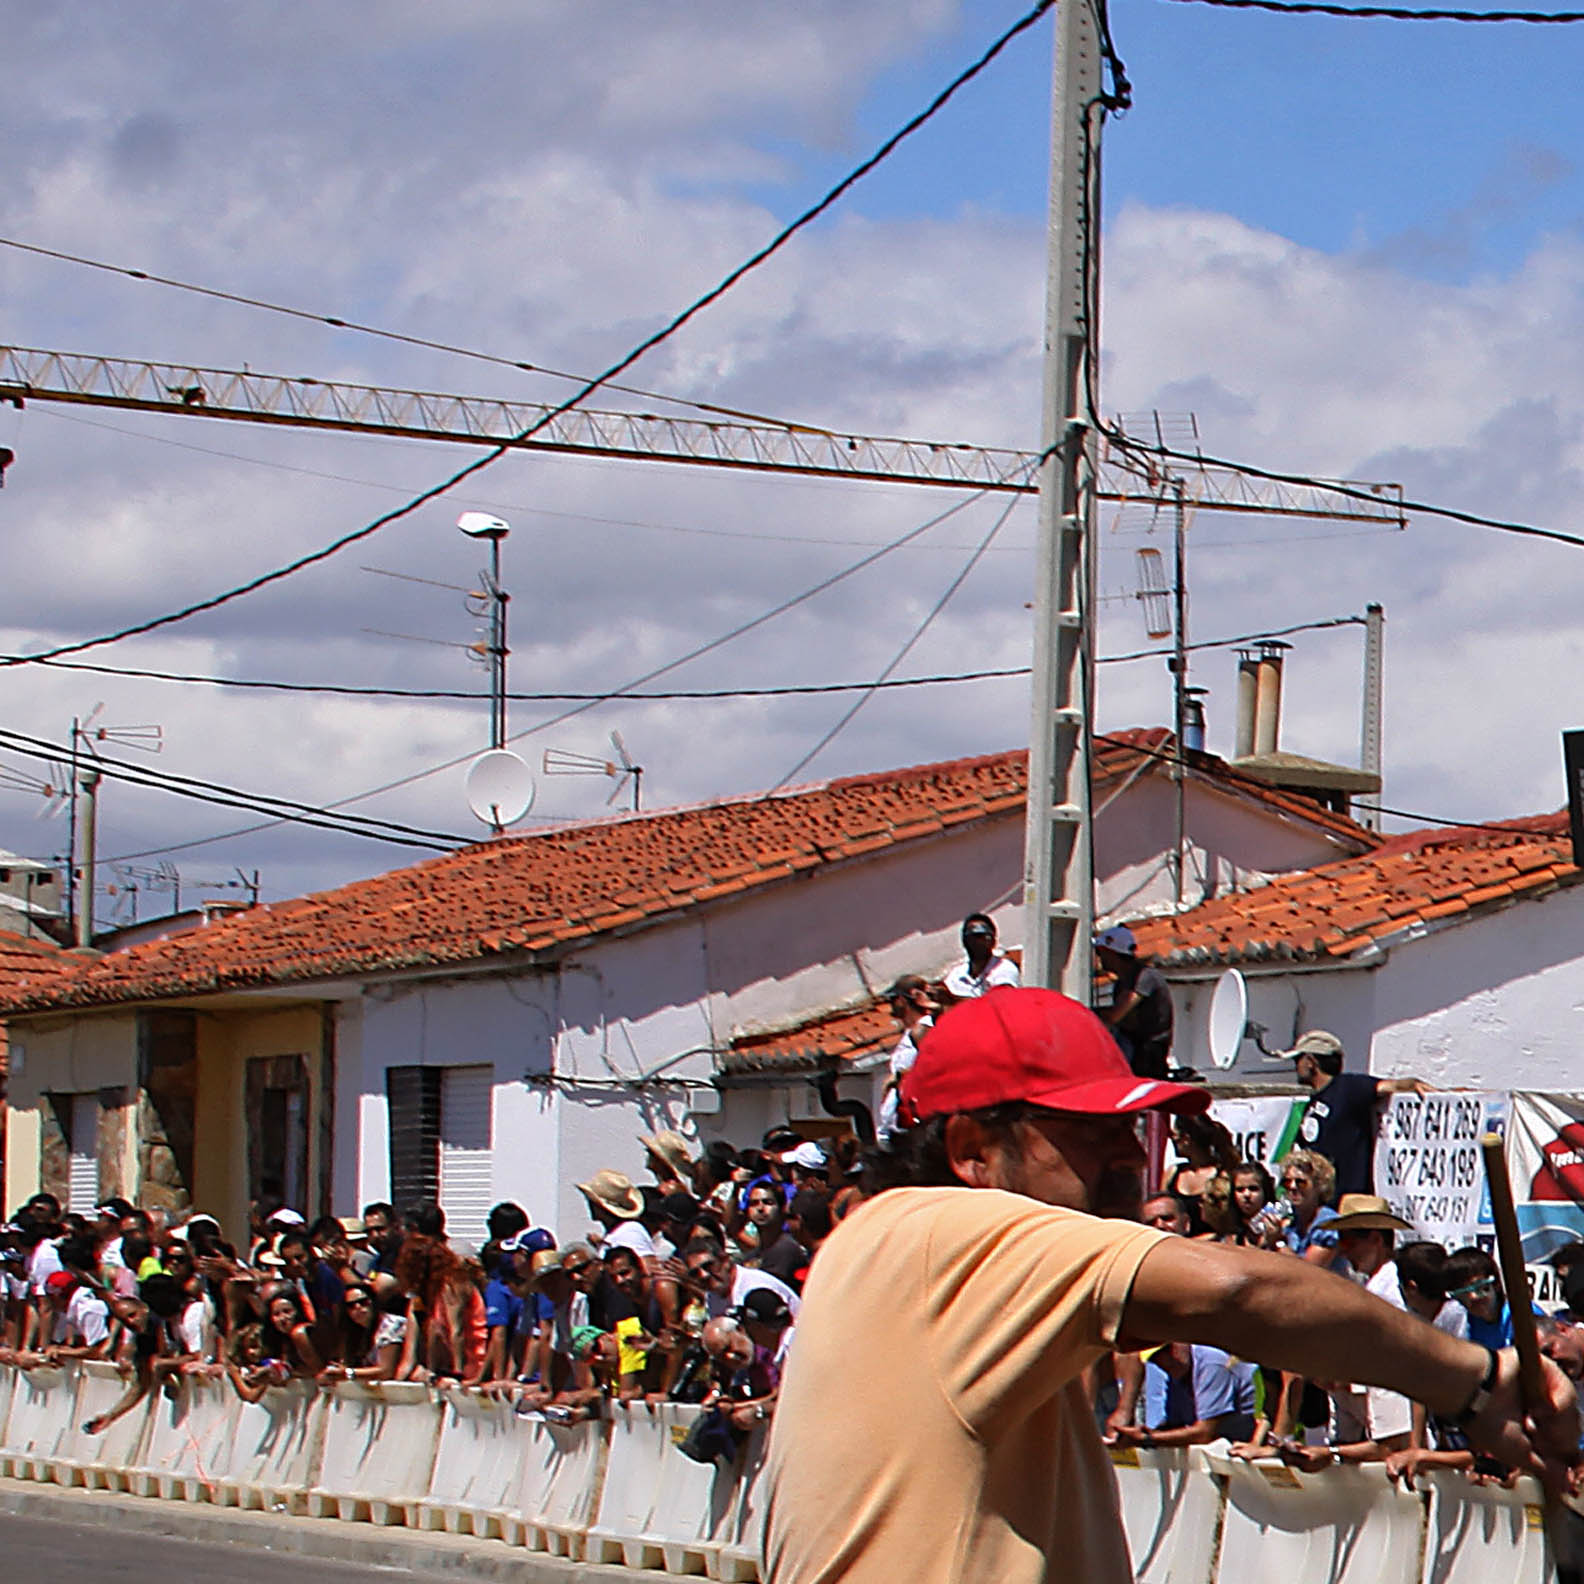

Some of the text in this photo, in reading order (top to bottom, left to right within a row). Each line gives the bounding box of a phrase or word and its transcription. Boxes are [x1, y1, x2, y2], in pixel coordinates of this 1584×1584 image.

[1395, 1100, 1481, 1141] 987 641 269
[1388, 1147, 1478, 1188] 987 643 198
